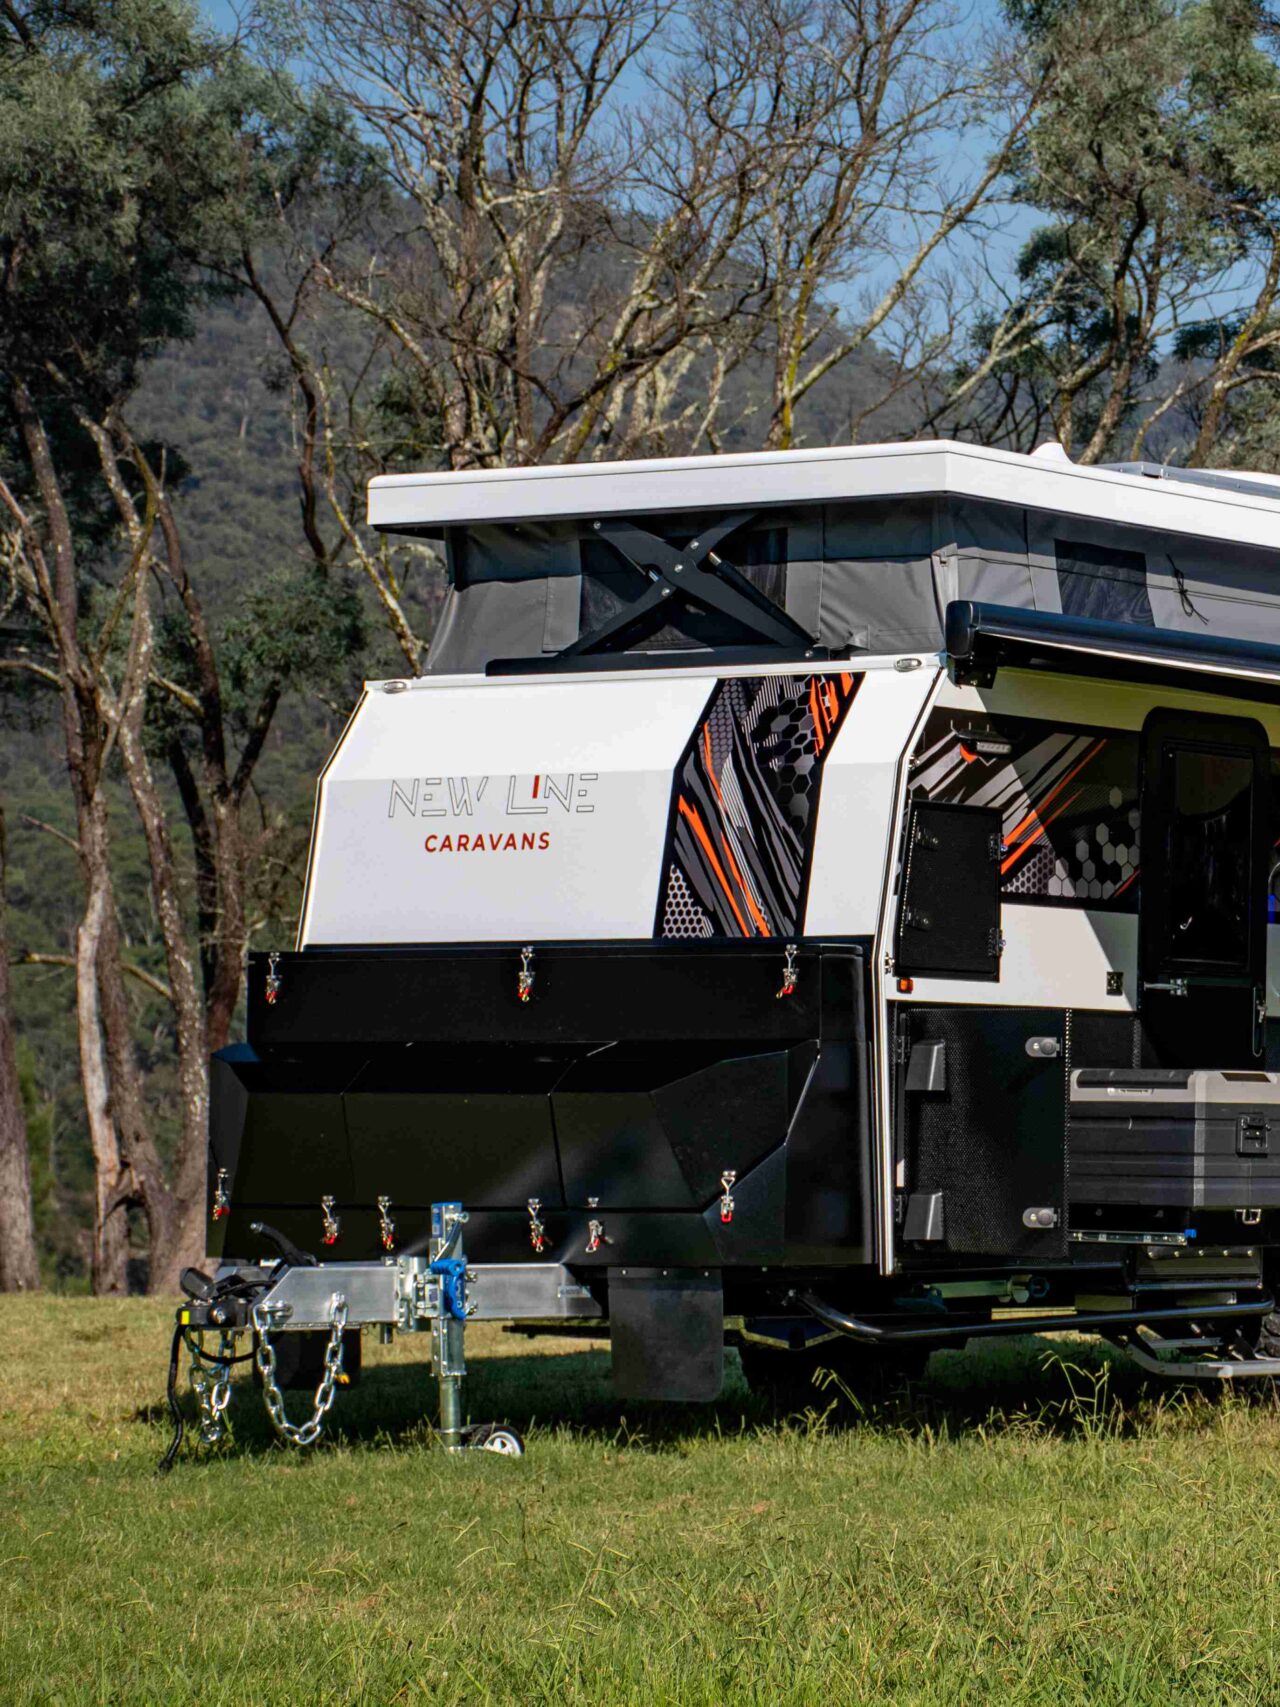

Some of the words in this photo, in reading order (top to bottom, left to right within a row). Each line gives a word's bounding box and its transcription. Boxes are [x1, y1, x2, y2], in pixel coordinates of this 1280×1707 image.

[388, 776, 489, 818] NEW
[506, 773, 599, 815] LINE
[424, 832, 550, 853] CARAVANS
